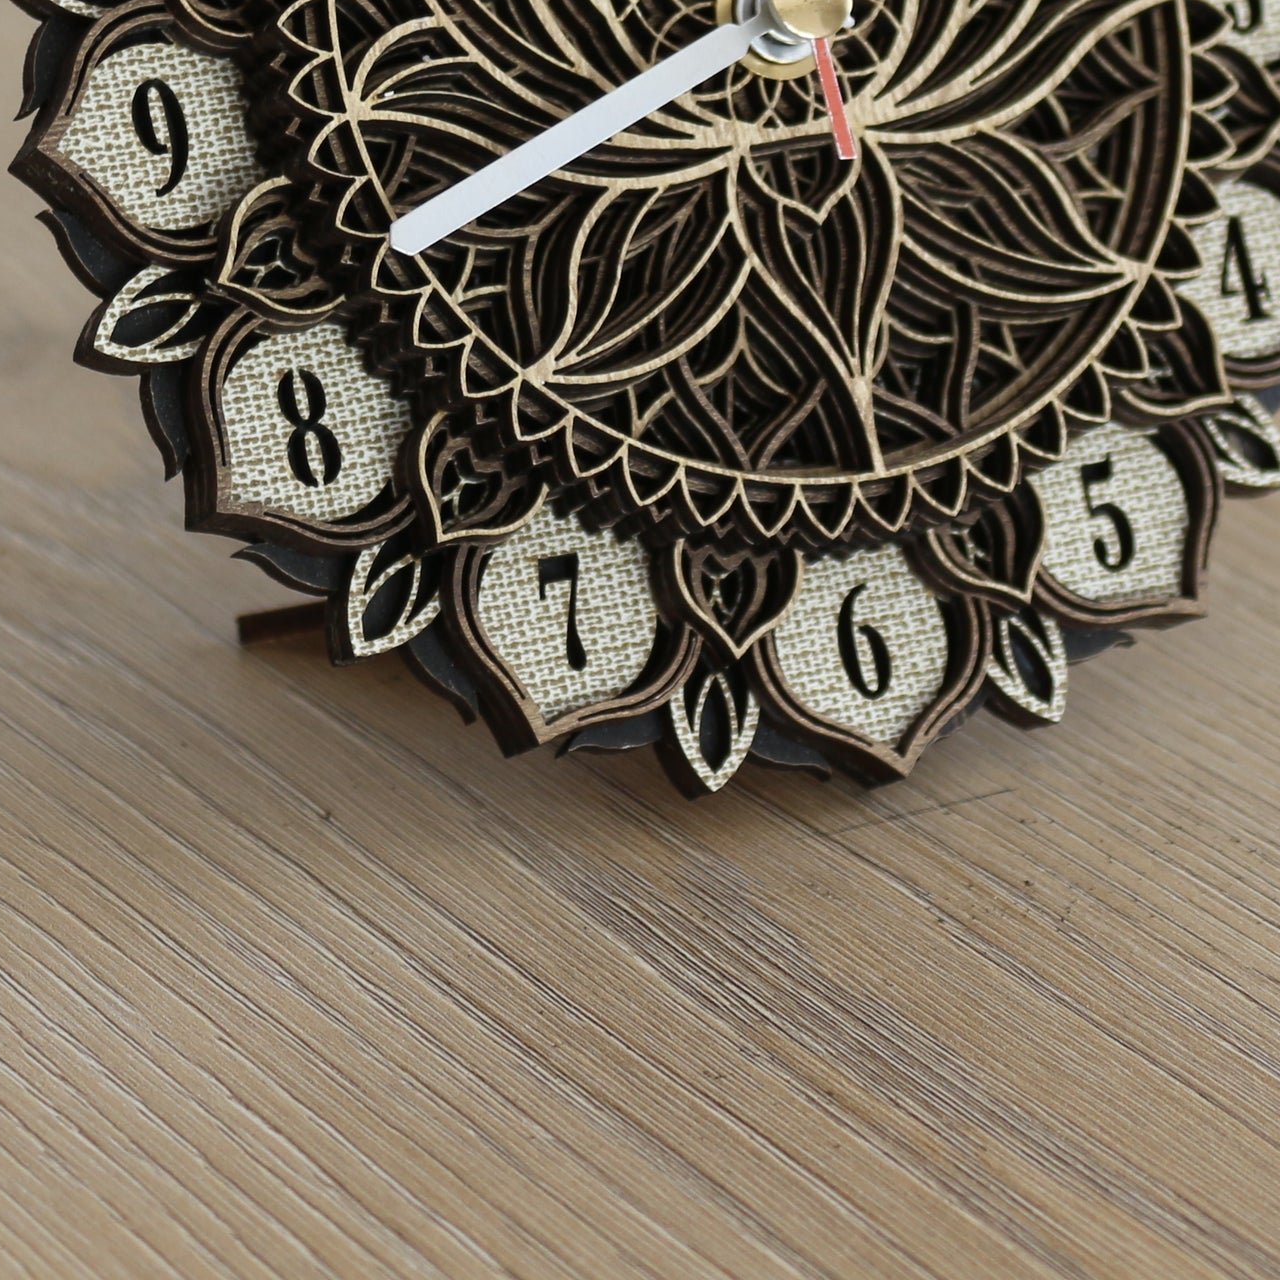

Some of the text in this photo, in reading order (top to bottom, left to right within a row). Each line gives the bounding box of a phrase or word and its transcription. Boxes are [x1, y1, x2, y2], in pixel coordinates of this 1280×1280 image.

[131, 78, 189, 197] 9
[1220, 216, 1271, 321] 4
[277, 368, 342, 486] 8
[1079, 452, 1135, 571] 5
[538, 552, 587, 671] 7
[837, 583, 892, 699] 6
